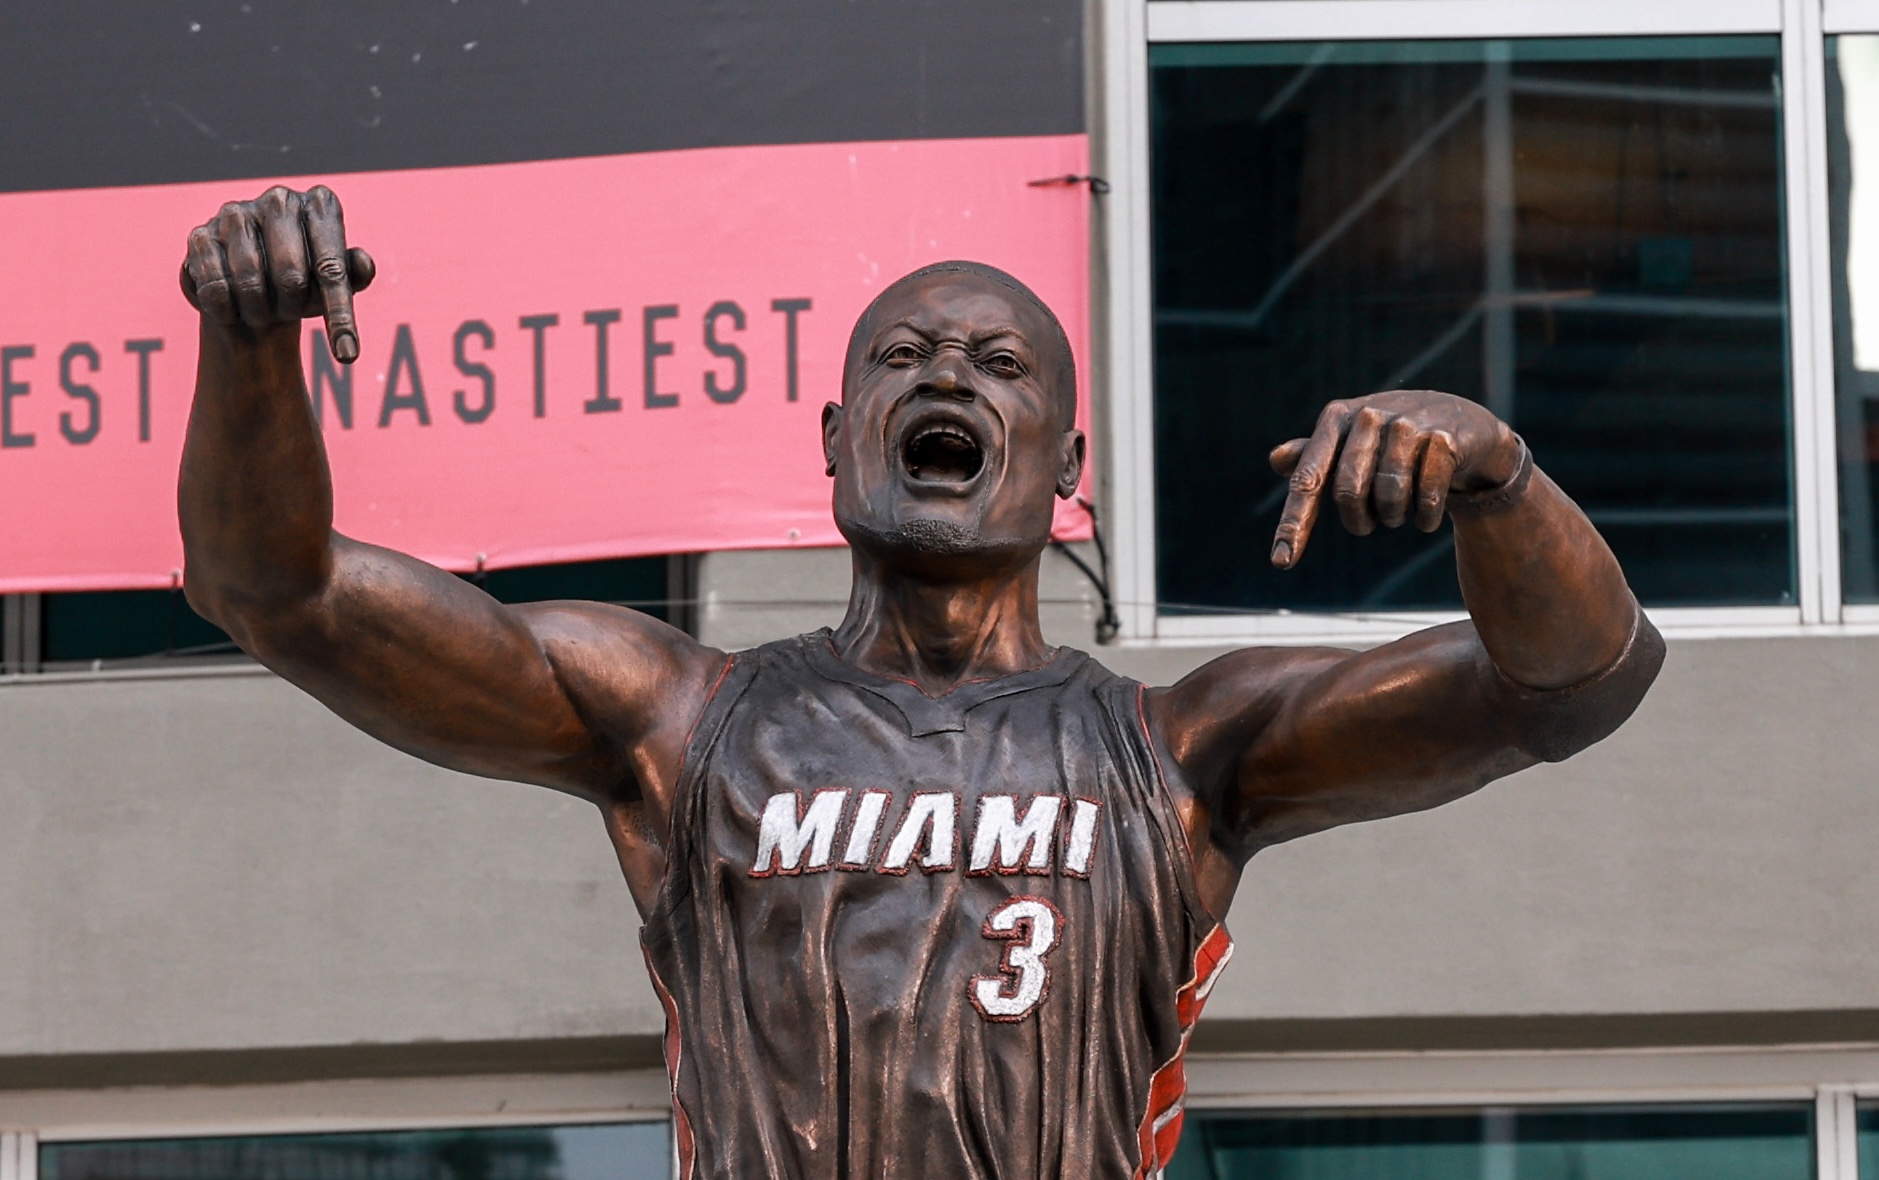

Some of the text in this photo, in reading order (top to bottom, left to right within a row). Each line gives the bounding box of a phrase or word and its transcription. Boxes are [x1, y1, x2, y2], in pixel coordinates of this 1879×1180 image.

[0, 298, 813, 448] EST NASTIEST
[748, 787, 1103, 880] MIAMI
[967, 895, 1066, 1023] 3
